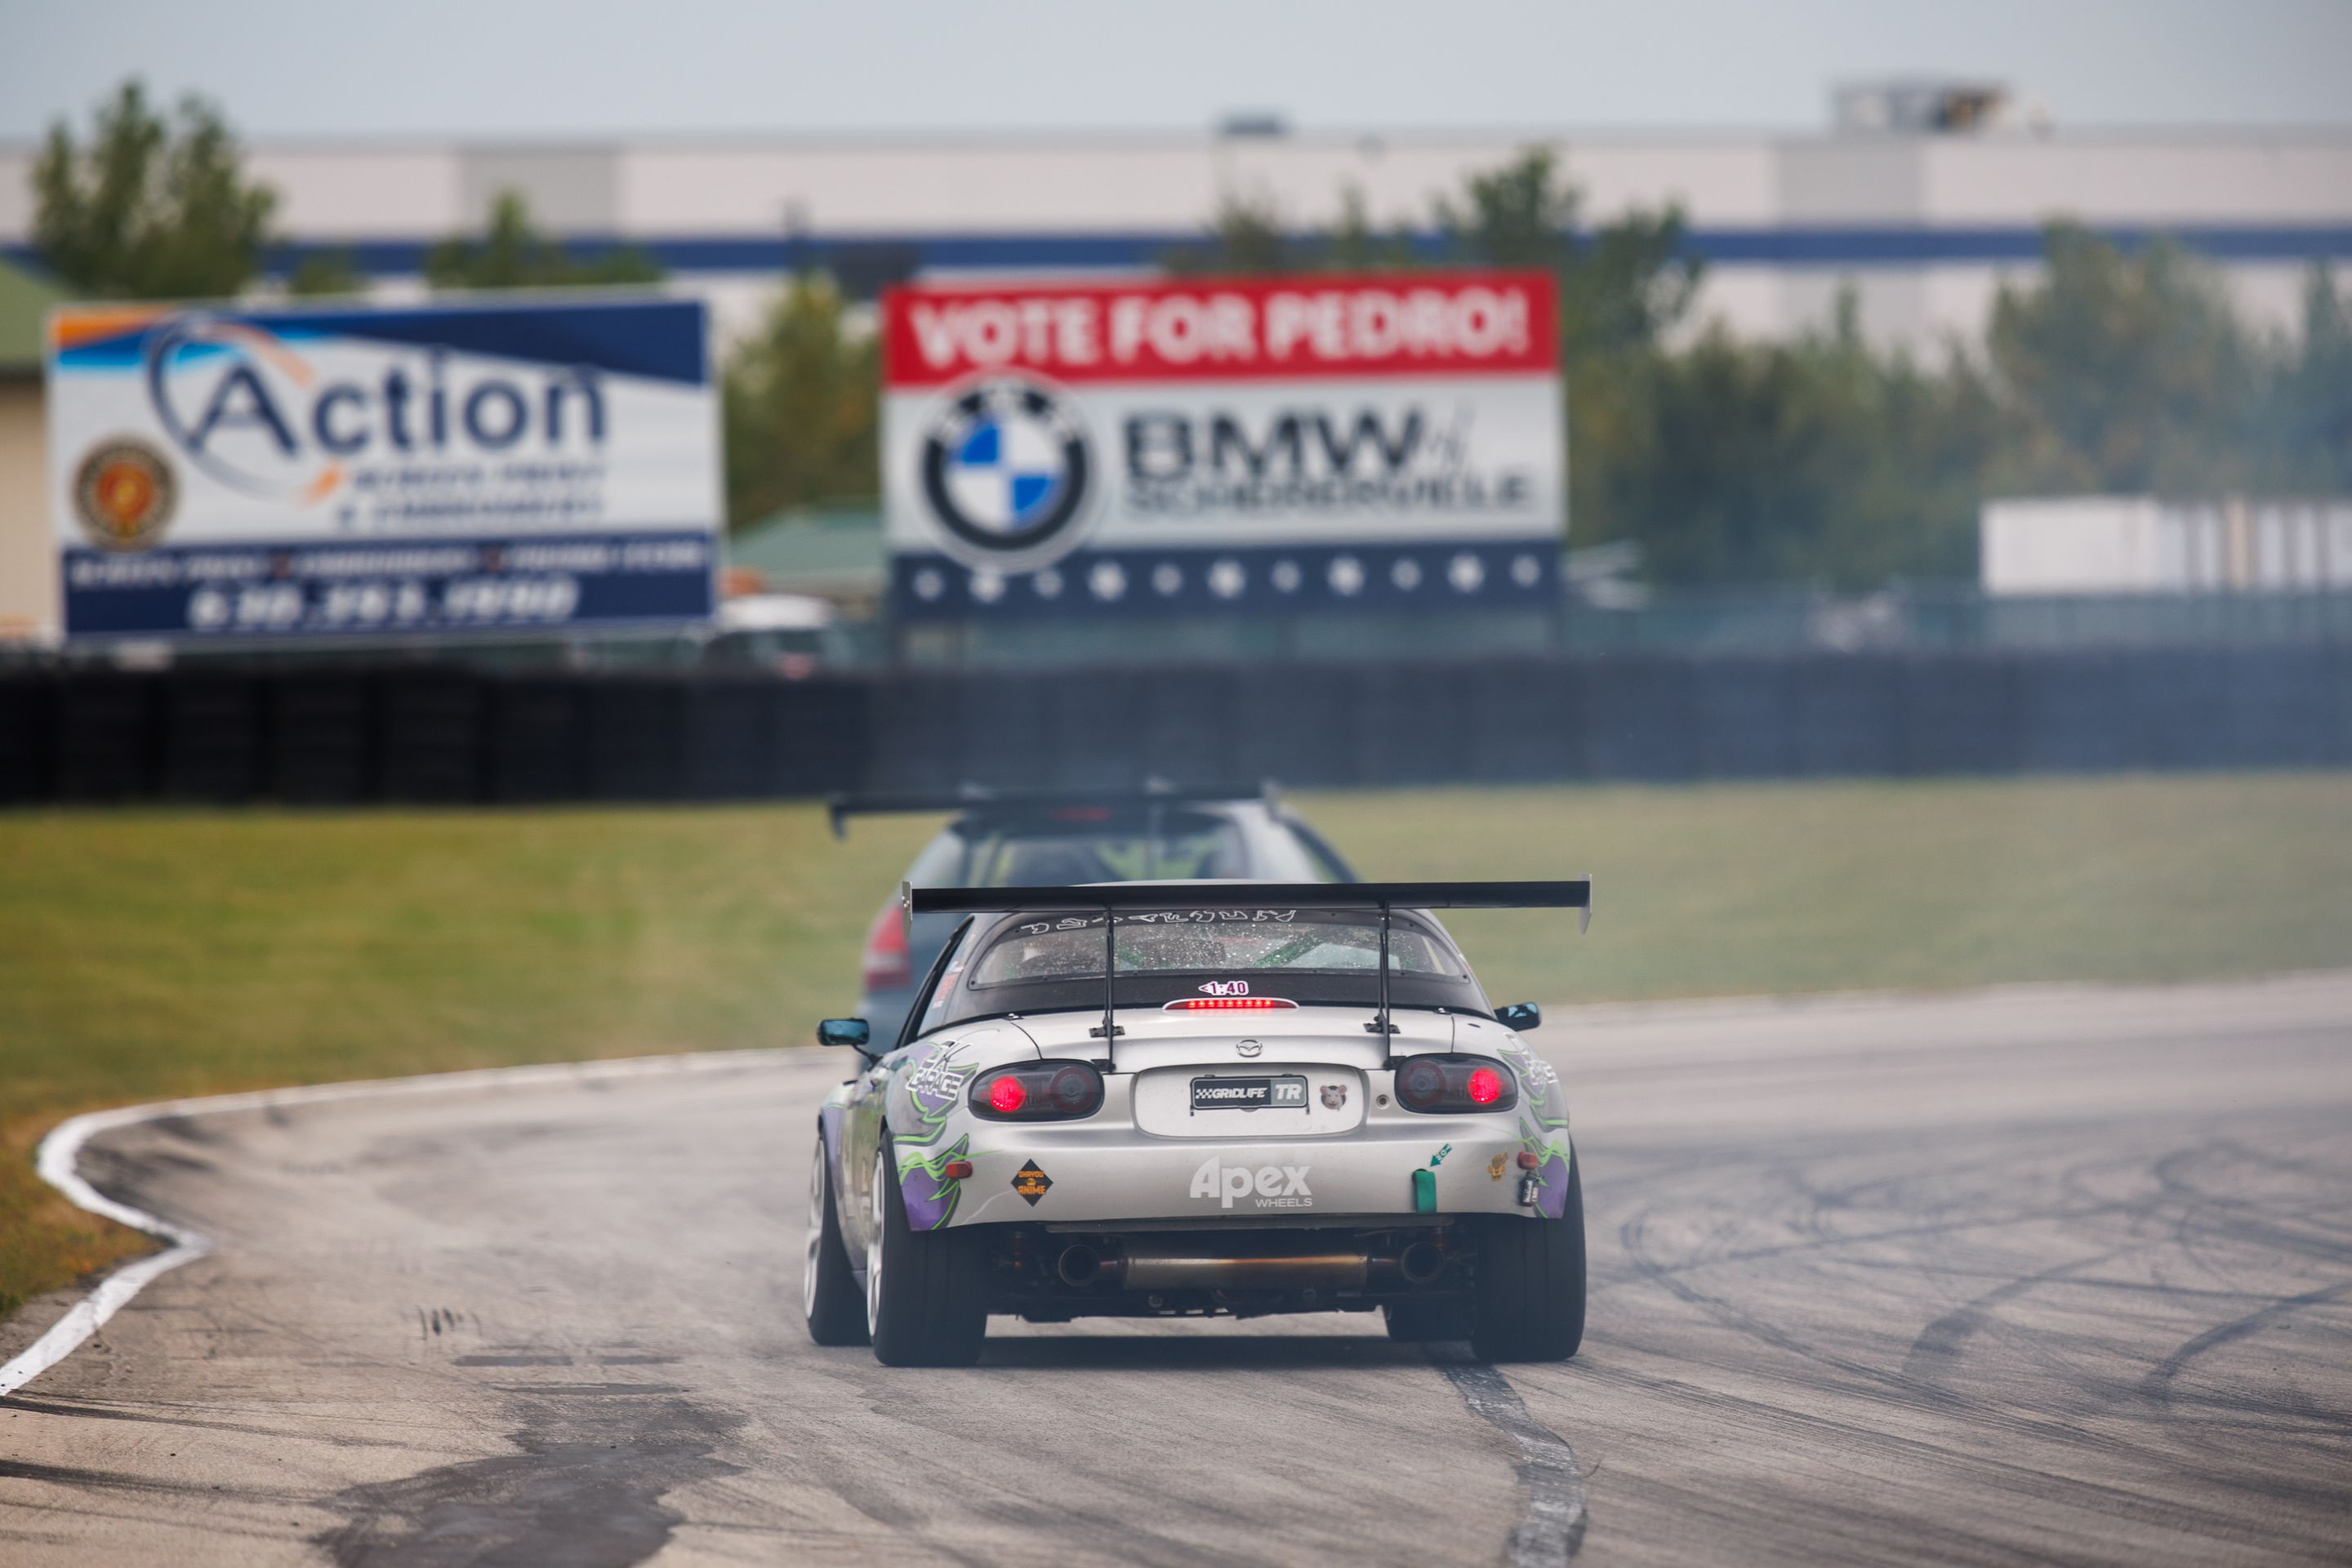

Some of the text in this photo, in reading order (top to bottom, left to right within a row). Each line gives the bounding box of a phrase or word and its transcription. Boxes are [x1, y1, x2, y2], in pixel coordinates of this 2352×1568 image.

[911, 289, 1530, 365] VOTE FOR PEDRO!
[185, 351, 610, 457] Action
[1120, 406, 1425, 480] BMW
[906, 1067, 964, 1100] GARAGE
[1212, 1084, 1302, 1100] GRIDLIFE TR
[1018, 1185, 1046, 1195] ANIME
[1190, 1156, 1312, 1209] Apex
[1255, 1198, 1313, 1208] WHEELS
